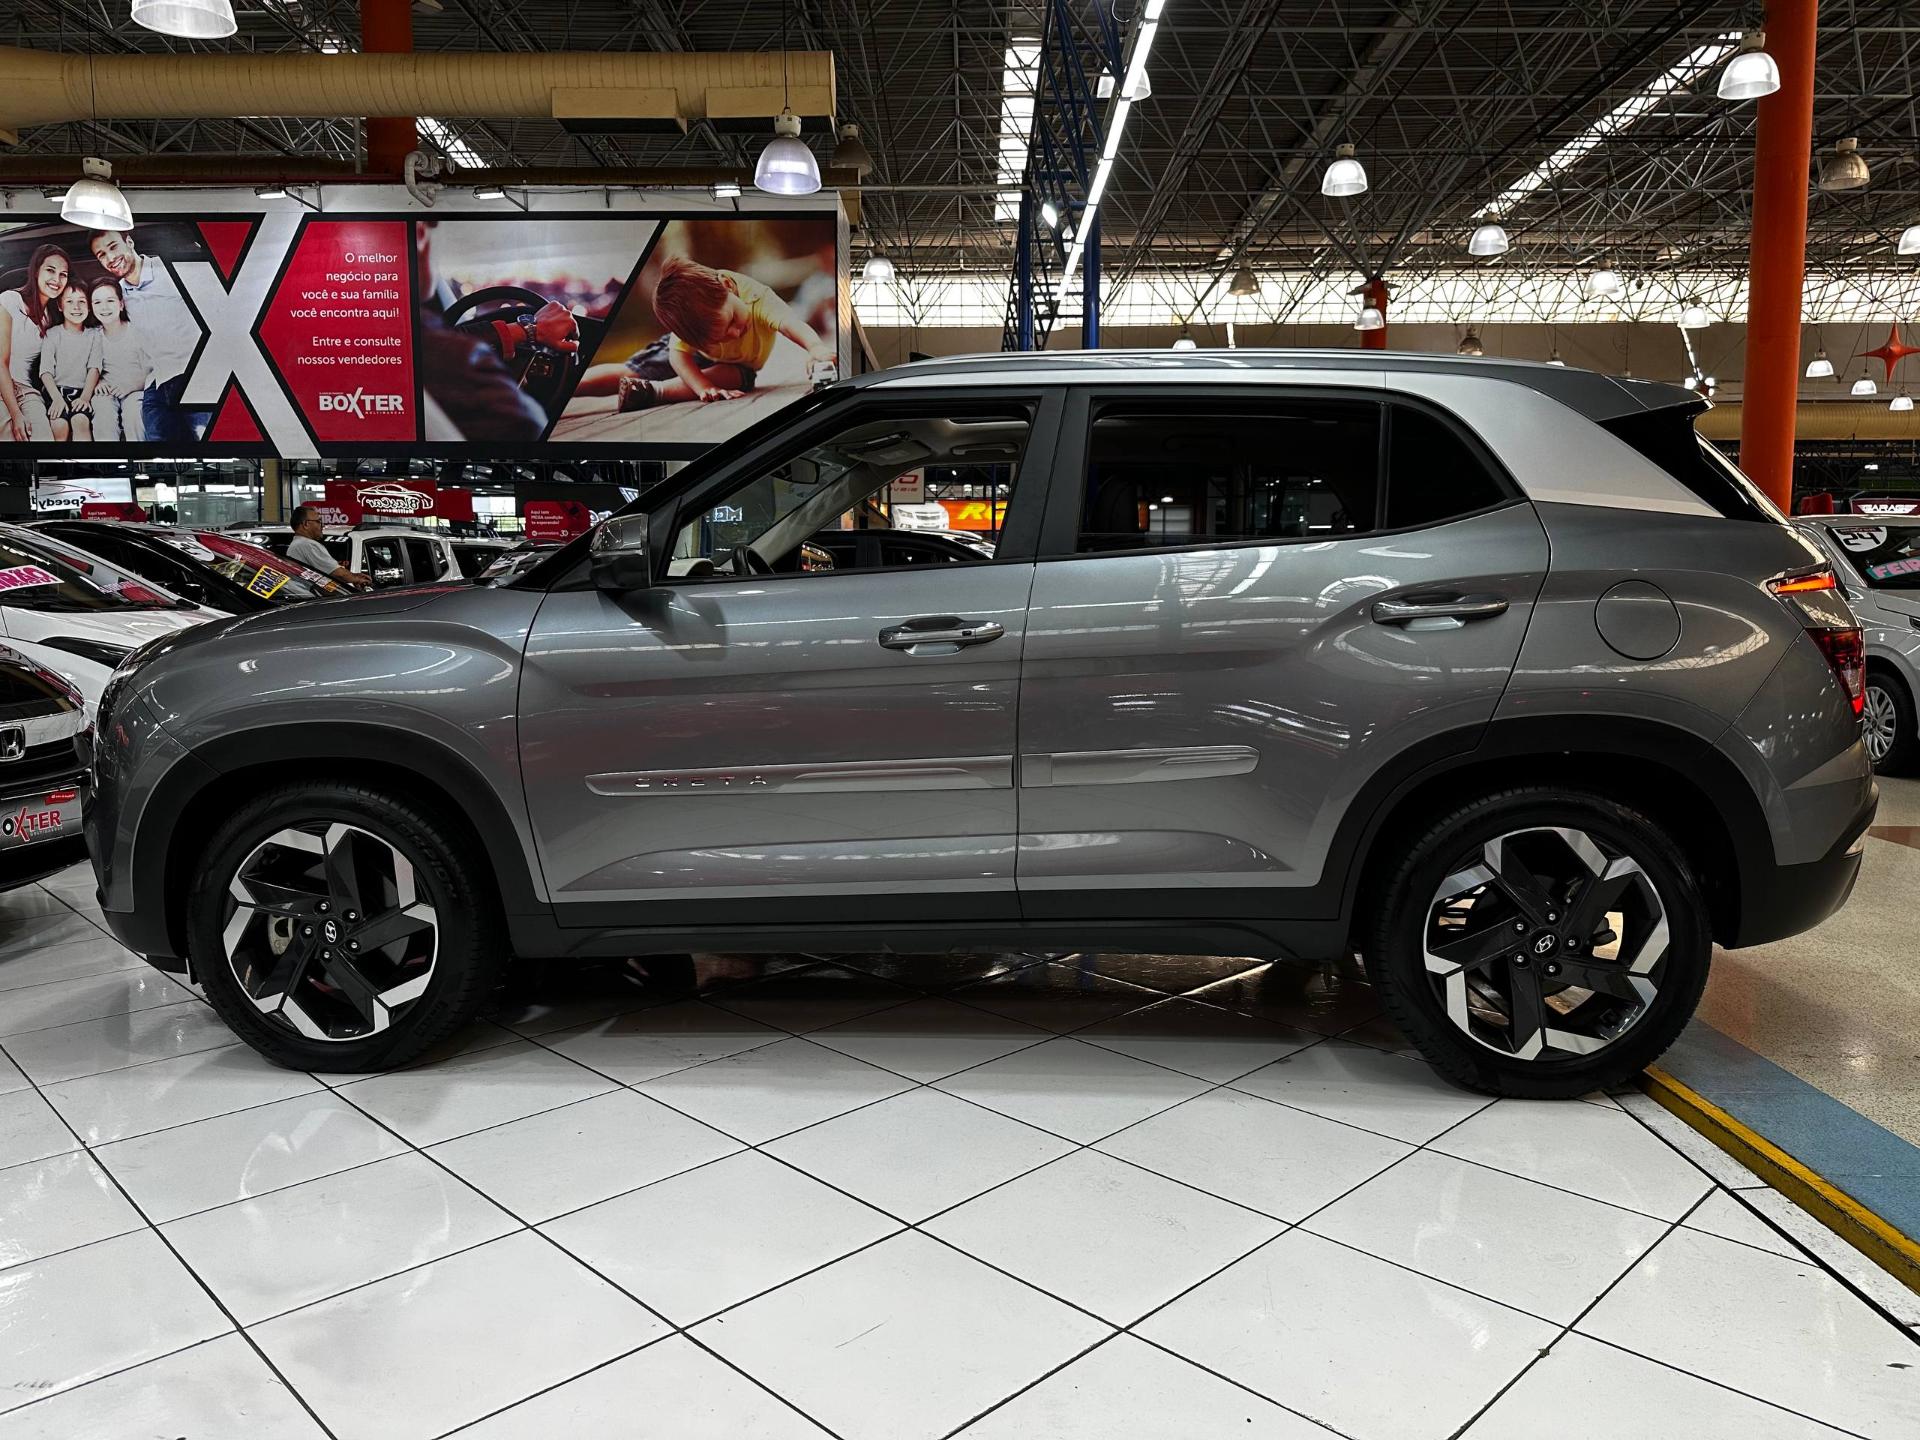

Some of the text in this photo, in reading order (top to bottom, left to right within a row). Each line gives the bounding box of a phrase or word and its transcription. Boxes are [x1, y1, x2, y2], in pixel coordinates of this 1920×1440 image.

[345, 252, 398, 263] O melhor
[326, 271, 399, 284] negócio para
[301, 288, 399, 300] você e sua família
[290, 307, 399, 320] você encontra aqui!
[312, 336, 402, 347] Entre e consulte
[297, 354, 402, 365] nossos vendedores
[318, 386, 404, 419] BOXTER
[319, 513, 350, 524] IRÃO
[1841, 532, 1881, 546] 24
[634, 774, 768, 788] CRETA
[1, 806, 63, 842] OXTER
